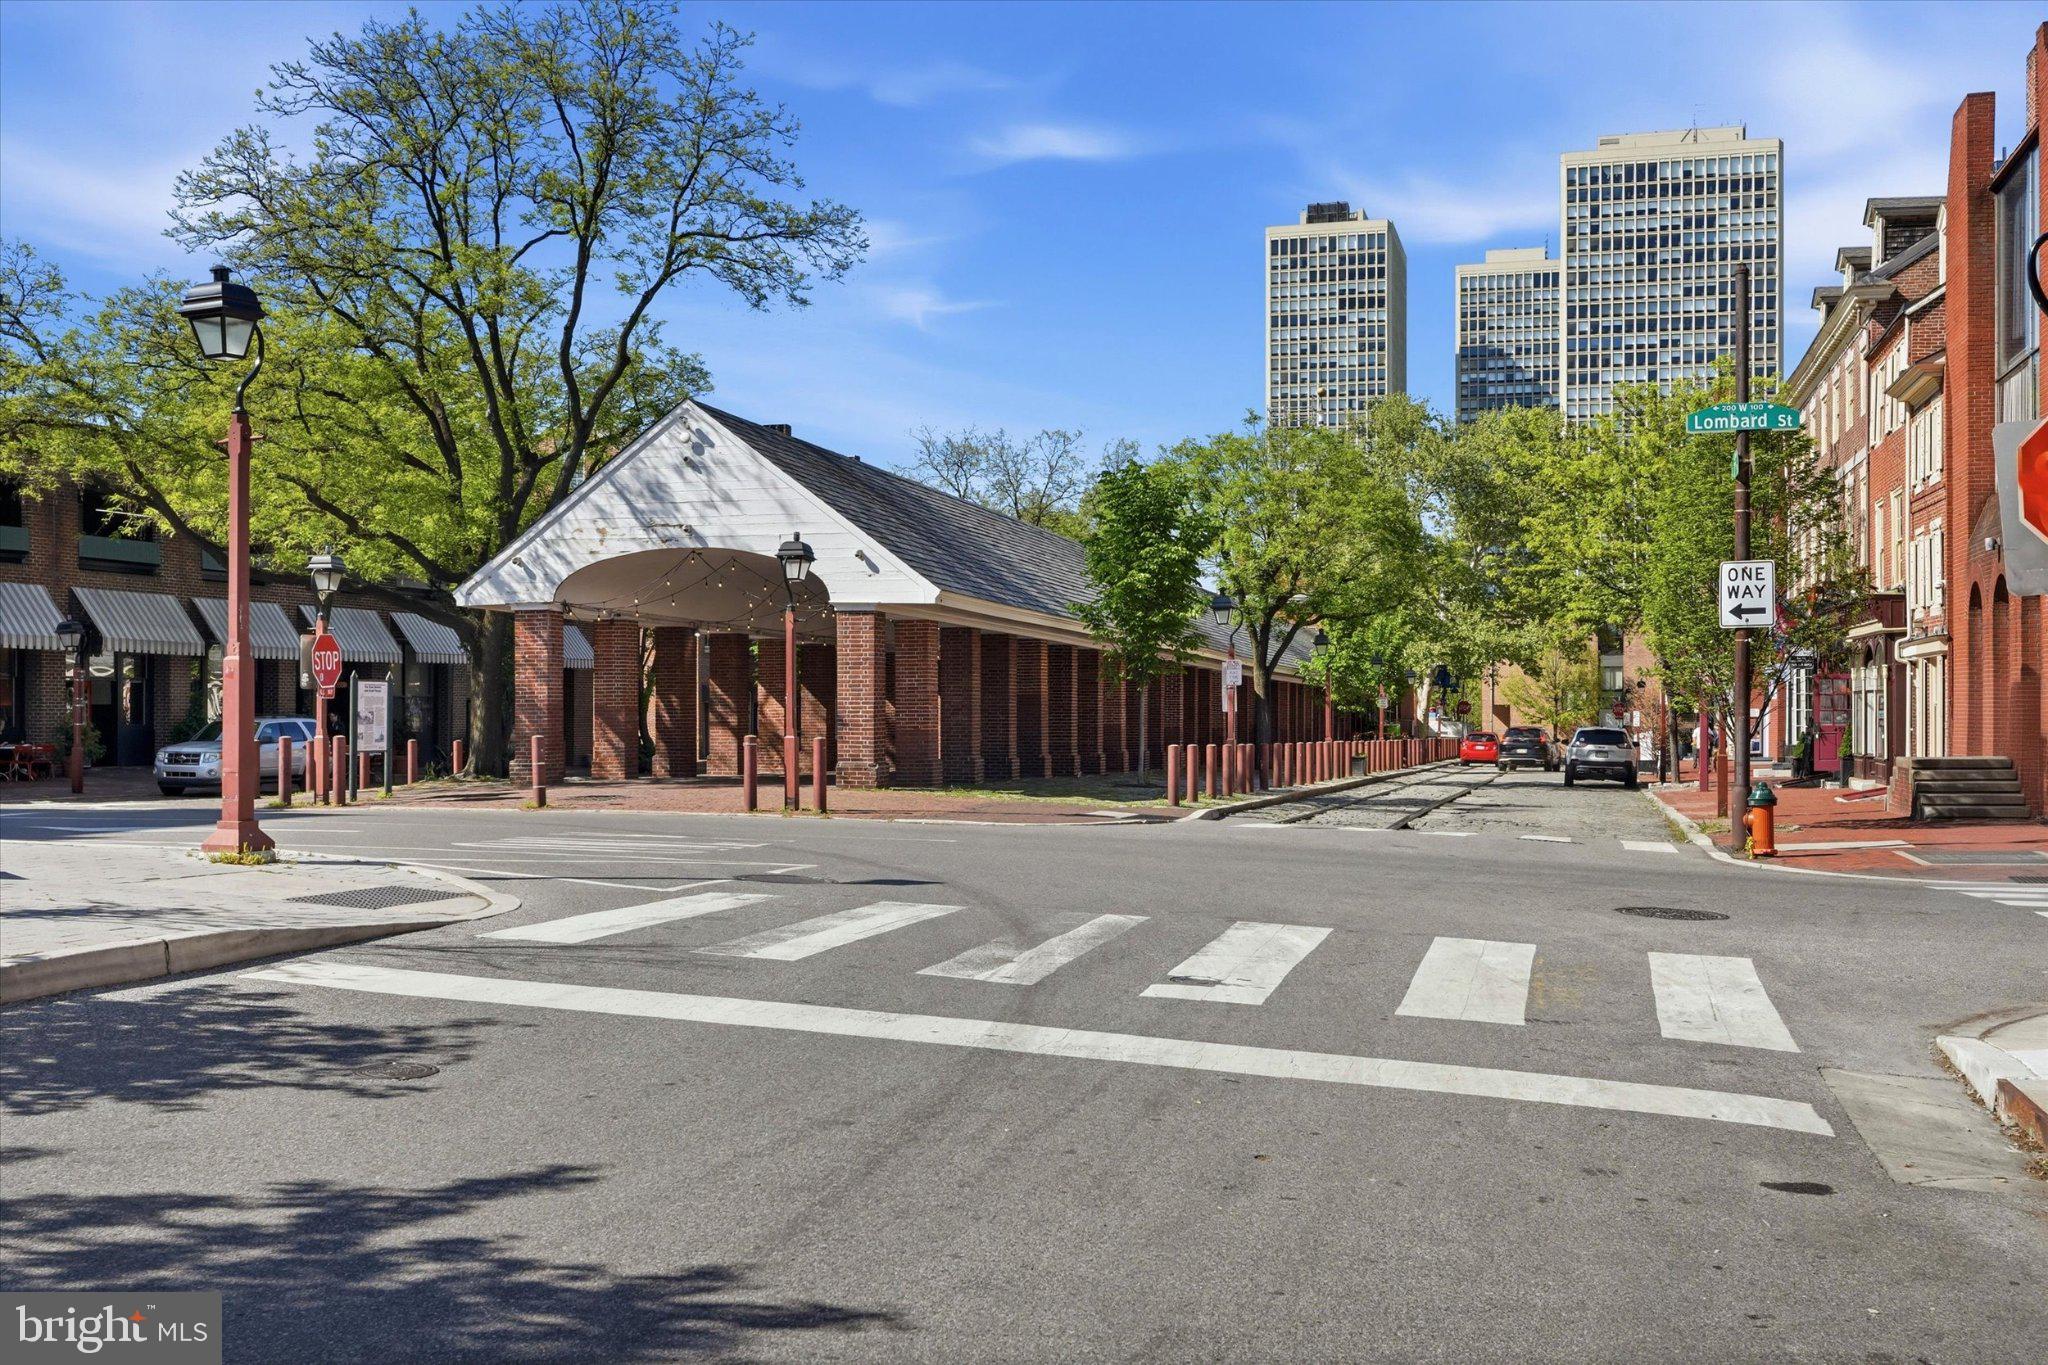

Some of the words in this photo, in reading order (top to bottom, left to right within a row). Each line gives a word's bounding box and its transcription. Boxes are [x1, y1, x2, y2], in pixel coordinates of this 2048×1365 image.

[1738, 403, 1747, 412] W
[1694, 413, 1767, 430] Lombard
[1777, 414, 1793, 427] St
[1728, 567, 1765, 581] ONE
[1727, 584, 1766, 599] WAY
[314, 651, 339, 670] STOP
